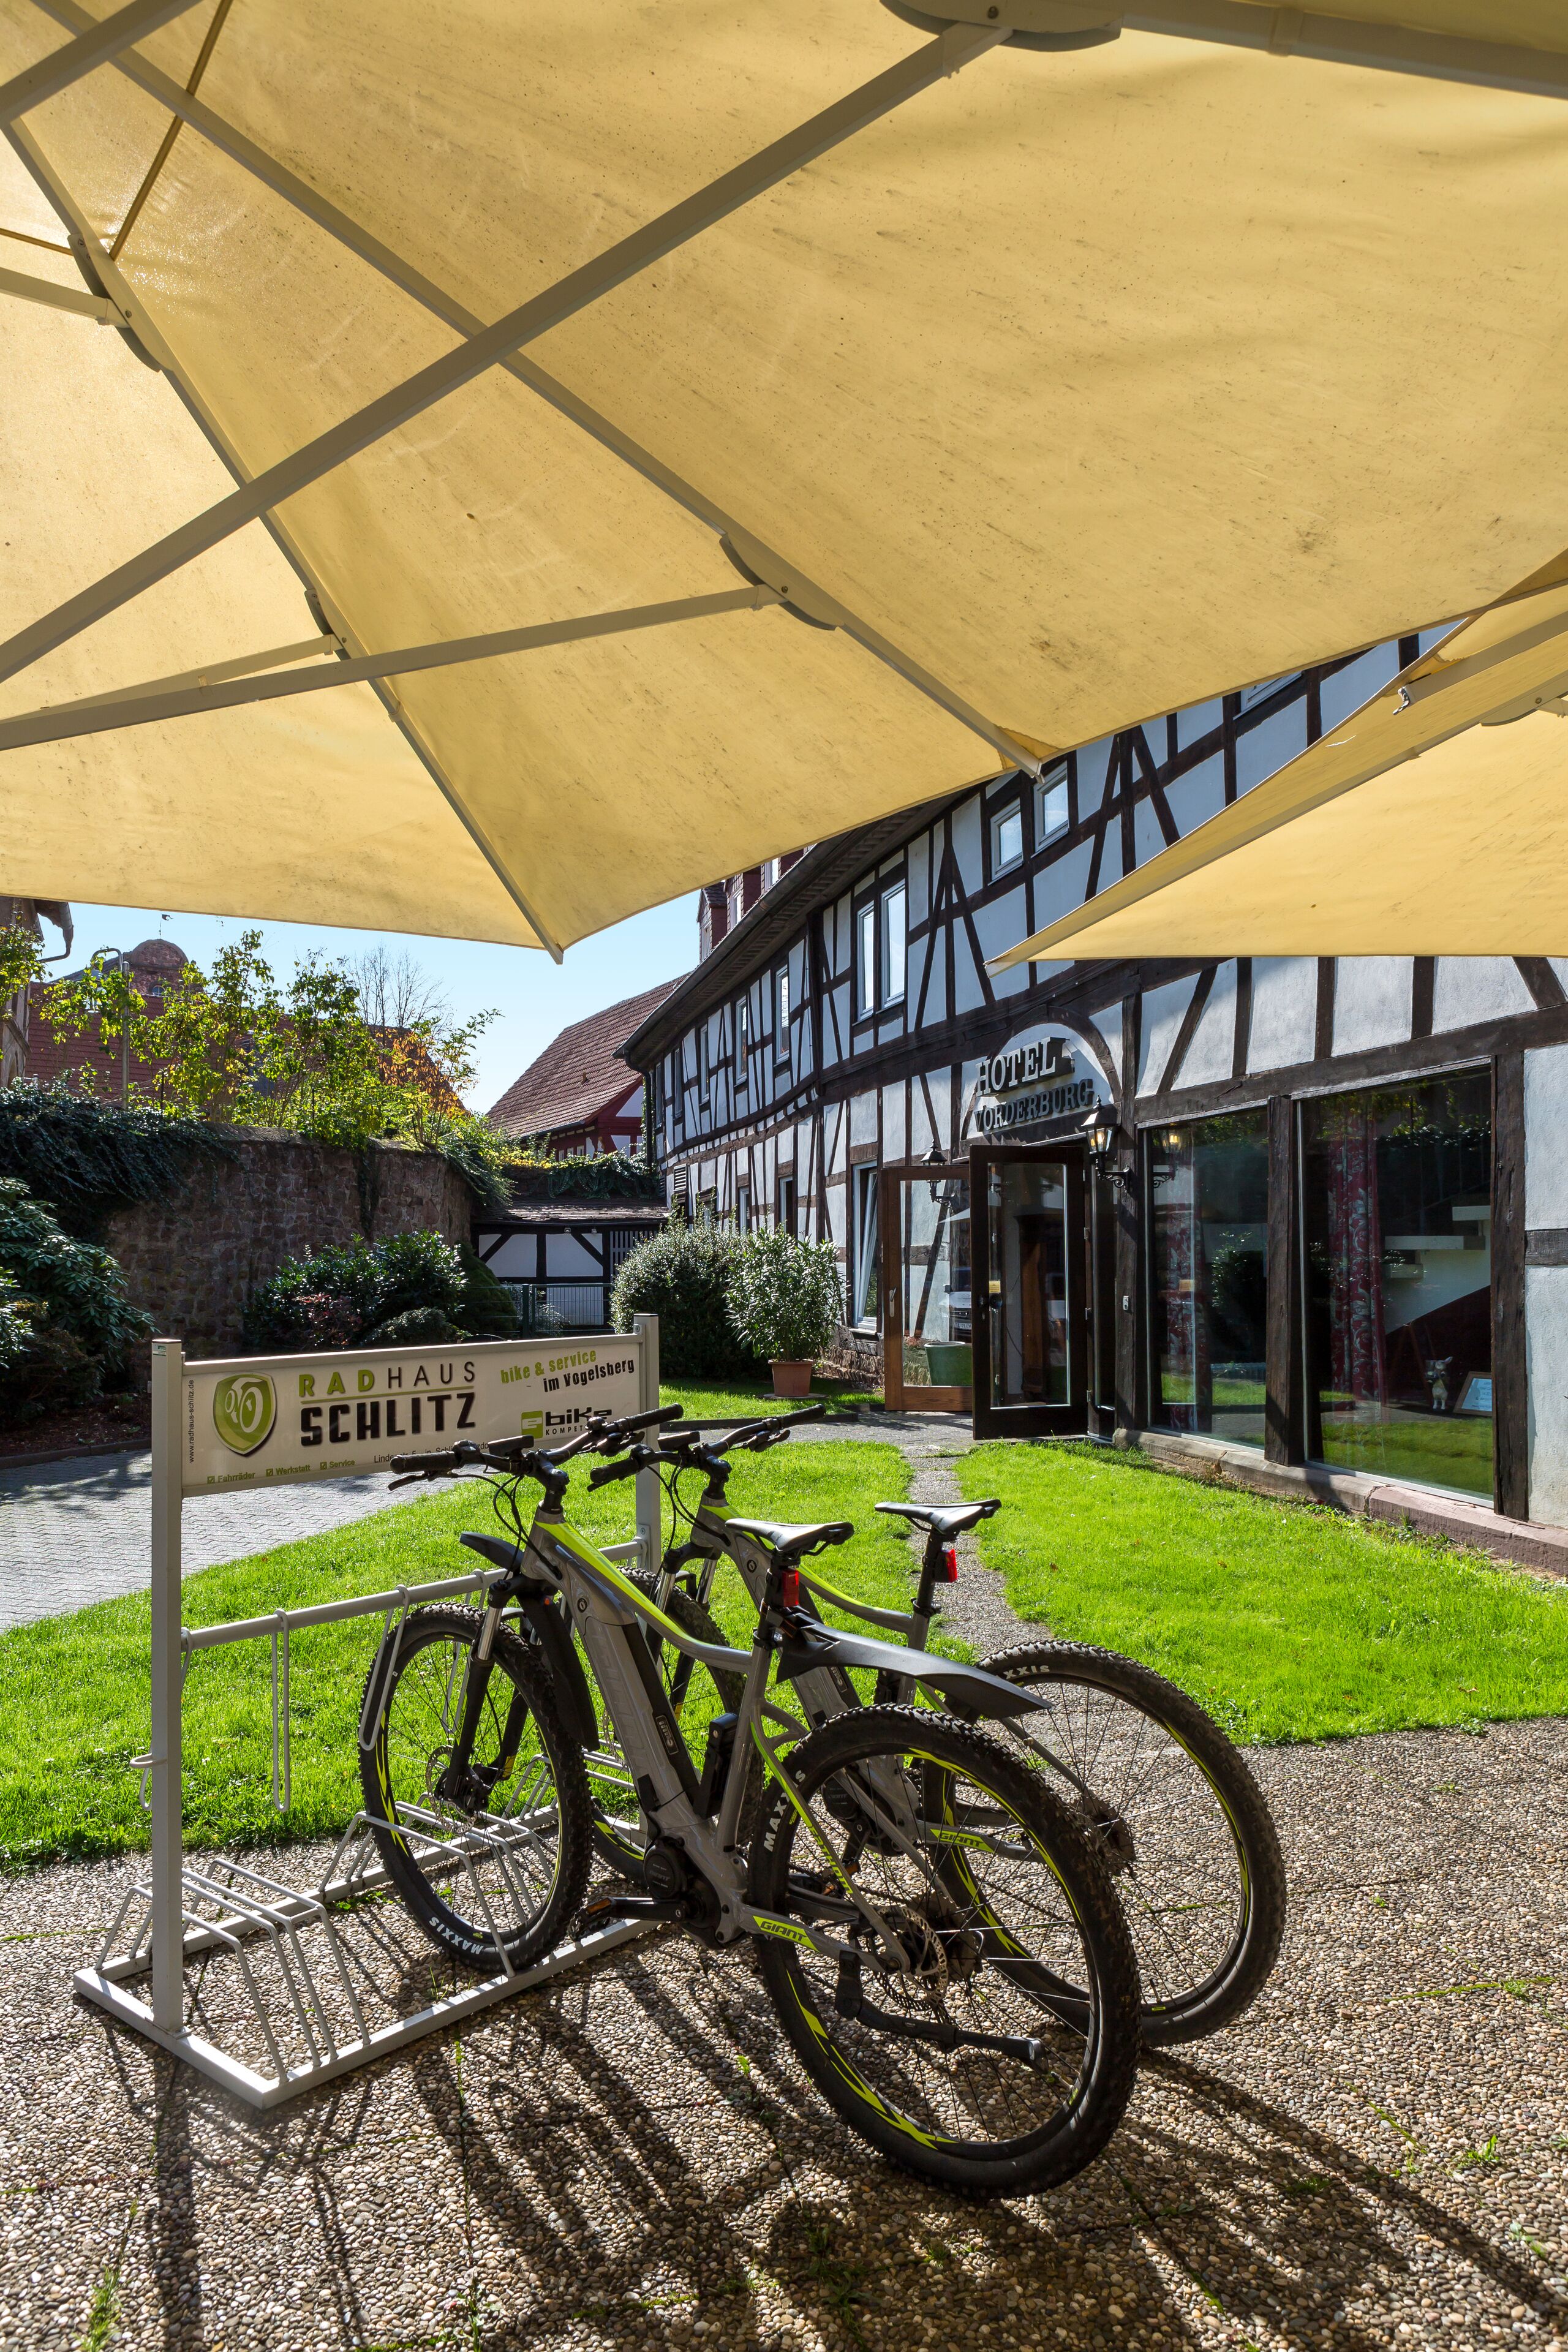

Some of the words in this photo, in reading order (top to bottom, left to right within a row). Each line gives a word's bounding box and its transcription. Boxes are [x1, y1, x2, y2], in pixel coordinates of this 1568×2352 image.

[975, 1036, 1061, 1097] HOTEL
[974, 1079, 1093, 1132] VORDERBURG
[298, 1361, 475, 1397] RADHAUS
[500, 1365, 530, 1384] bike
[535, 1362, 545, 1376] &
[549, 1350, 597, 1372] service
[543, 1377, 560, 1393] im
[564, 1359, 635, 1387] Vogelsberg
[300, 1392, 476, 1447] SCHLITZ
[217, 1472, 255, 1482] Fahrräder
[276, 1464, 311, 1476] Werkstatt
[329, 1459, 355, 1469] Service
[940, 1833, 984, 1847] GIANT
[429, 1917, 484, 1954] MAXXIS
[760, 1921, 807, 1941] GIANT
